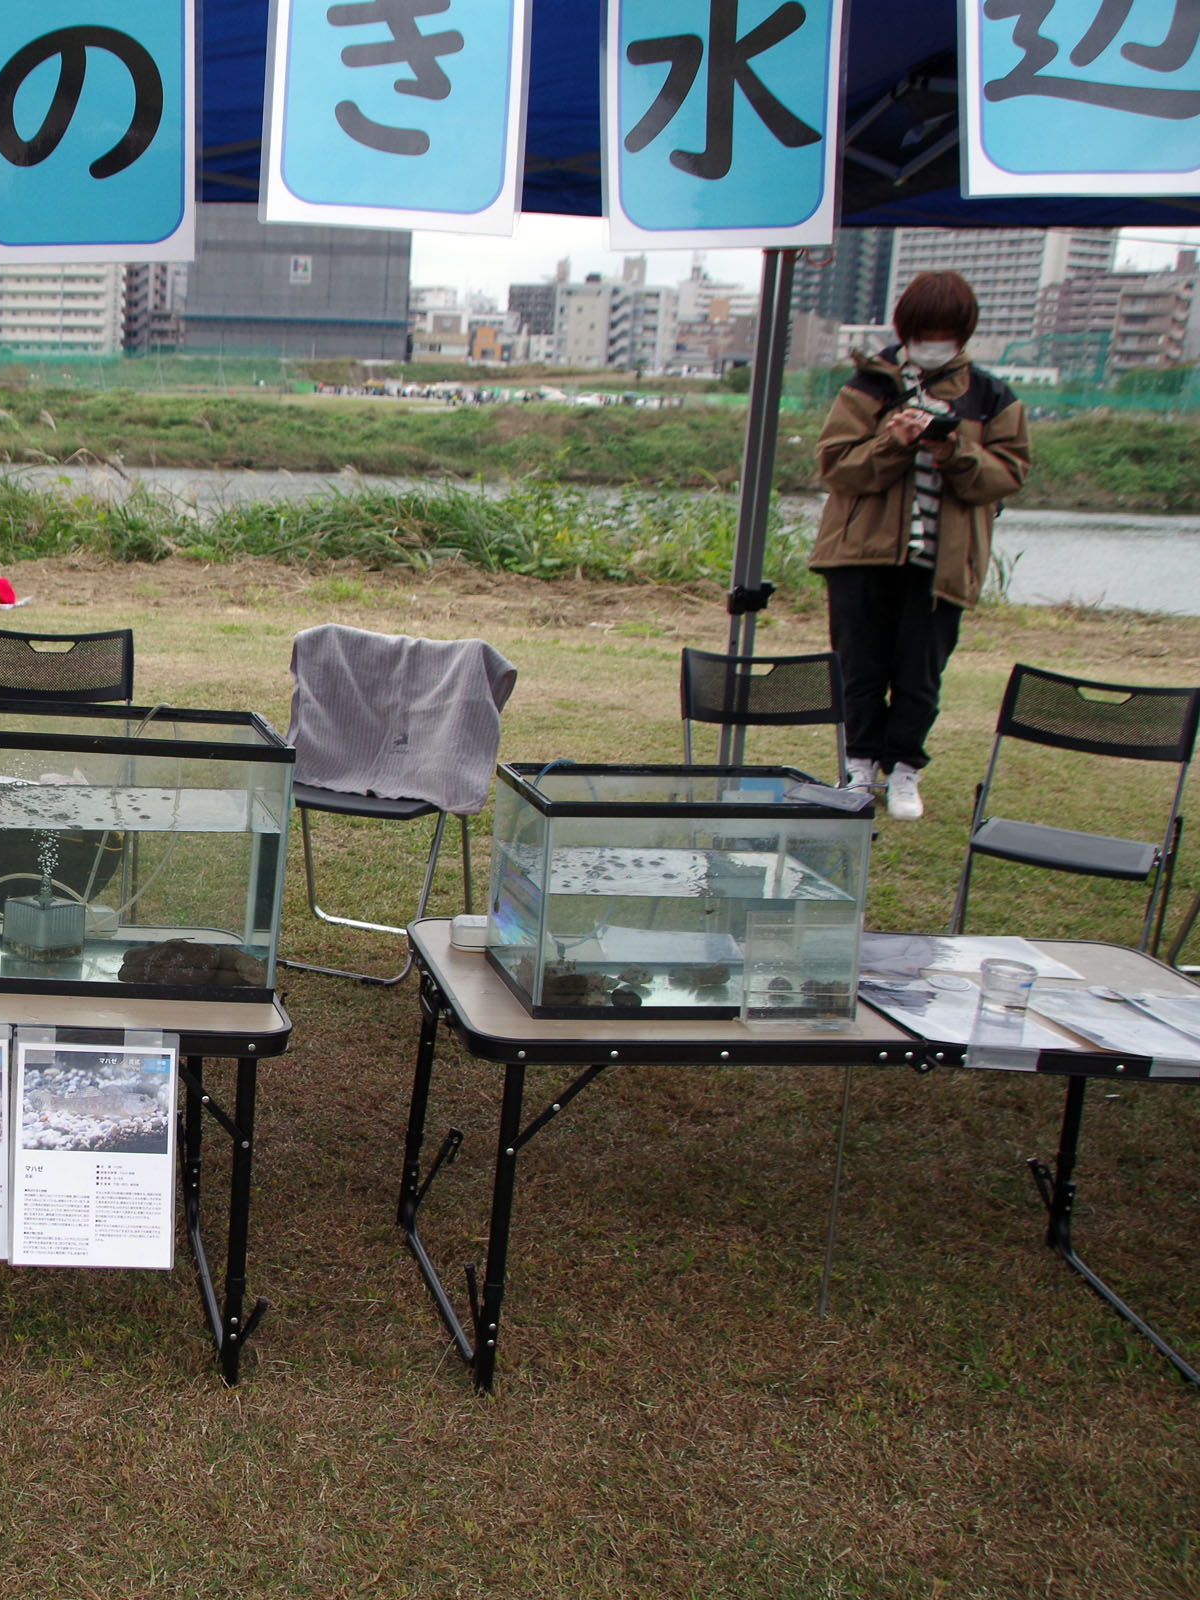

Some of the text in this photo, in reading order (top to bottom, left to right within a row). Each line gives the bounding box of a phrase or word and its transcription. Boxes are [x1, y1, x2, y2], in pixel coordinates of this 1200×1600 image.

[326, 0, 464, 156] き
[623, 0, 823, 180] 水
[25, 1165, 44, 1173] マハゼ
